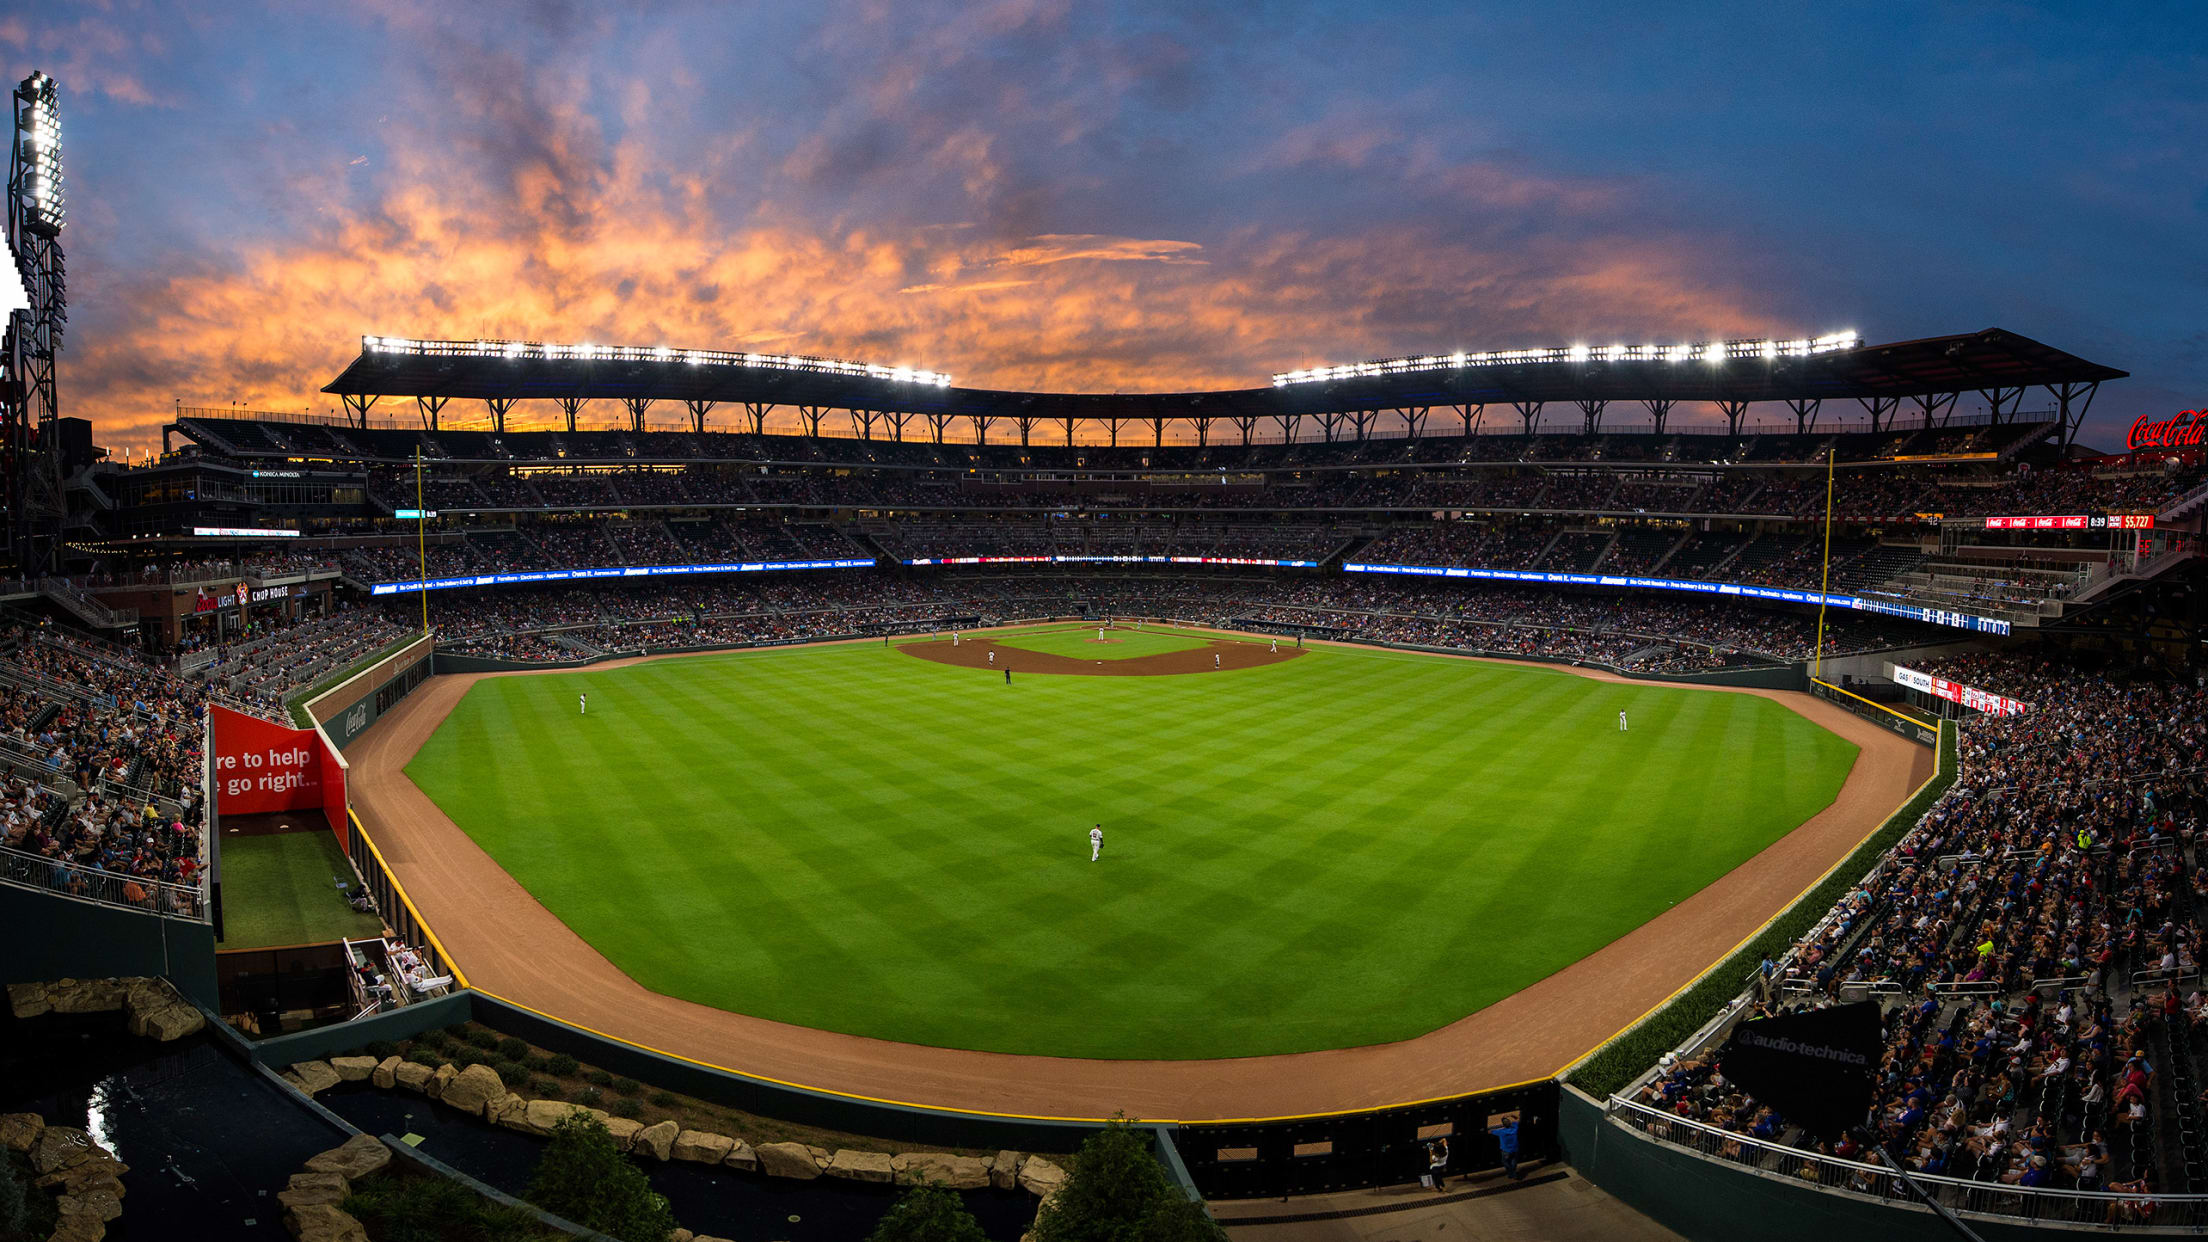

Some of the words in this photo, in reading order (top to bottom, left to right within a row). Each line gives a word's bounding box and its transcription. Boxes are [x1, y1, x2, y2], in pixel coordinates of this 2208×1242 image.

[2127, 408, 2208, 450] Coca-Cola
[2090, 517, 2105, 527] 8:39
[2125, 515, 2149, 529] $5,727
[218, 594, 235, 608] LIGHT
[252, 589, 269, 602] CHOP
[270, 586, 288, 599] HOUSE
[1898, 672, 1909, 682] GAS
[1912, 676, 1930, 688] SOUTH
[242, 752, 263, 768] to
[269, 747, 310, 768] help
[227, 778, 252, 796] go
